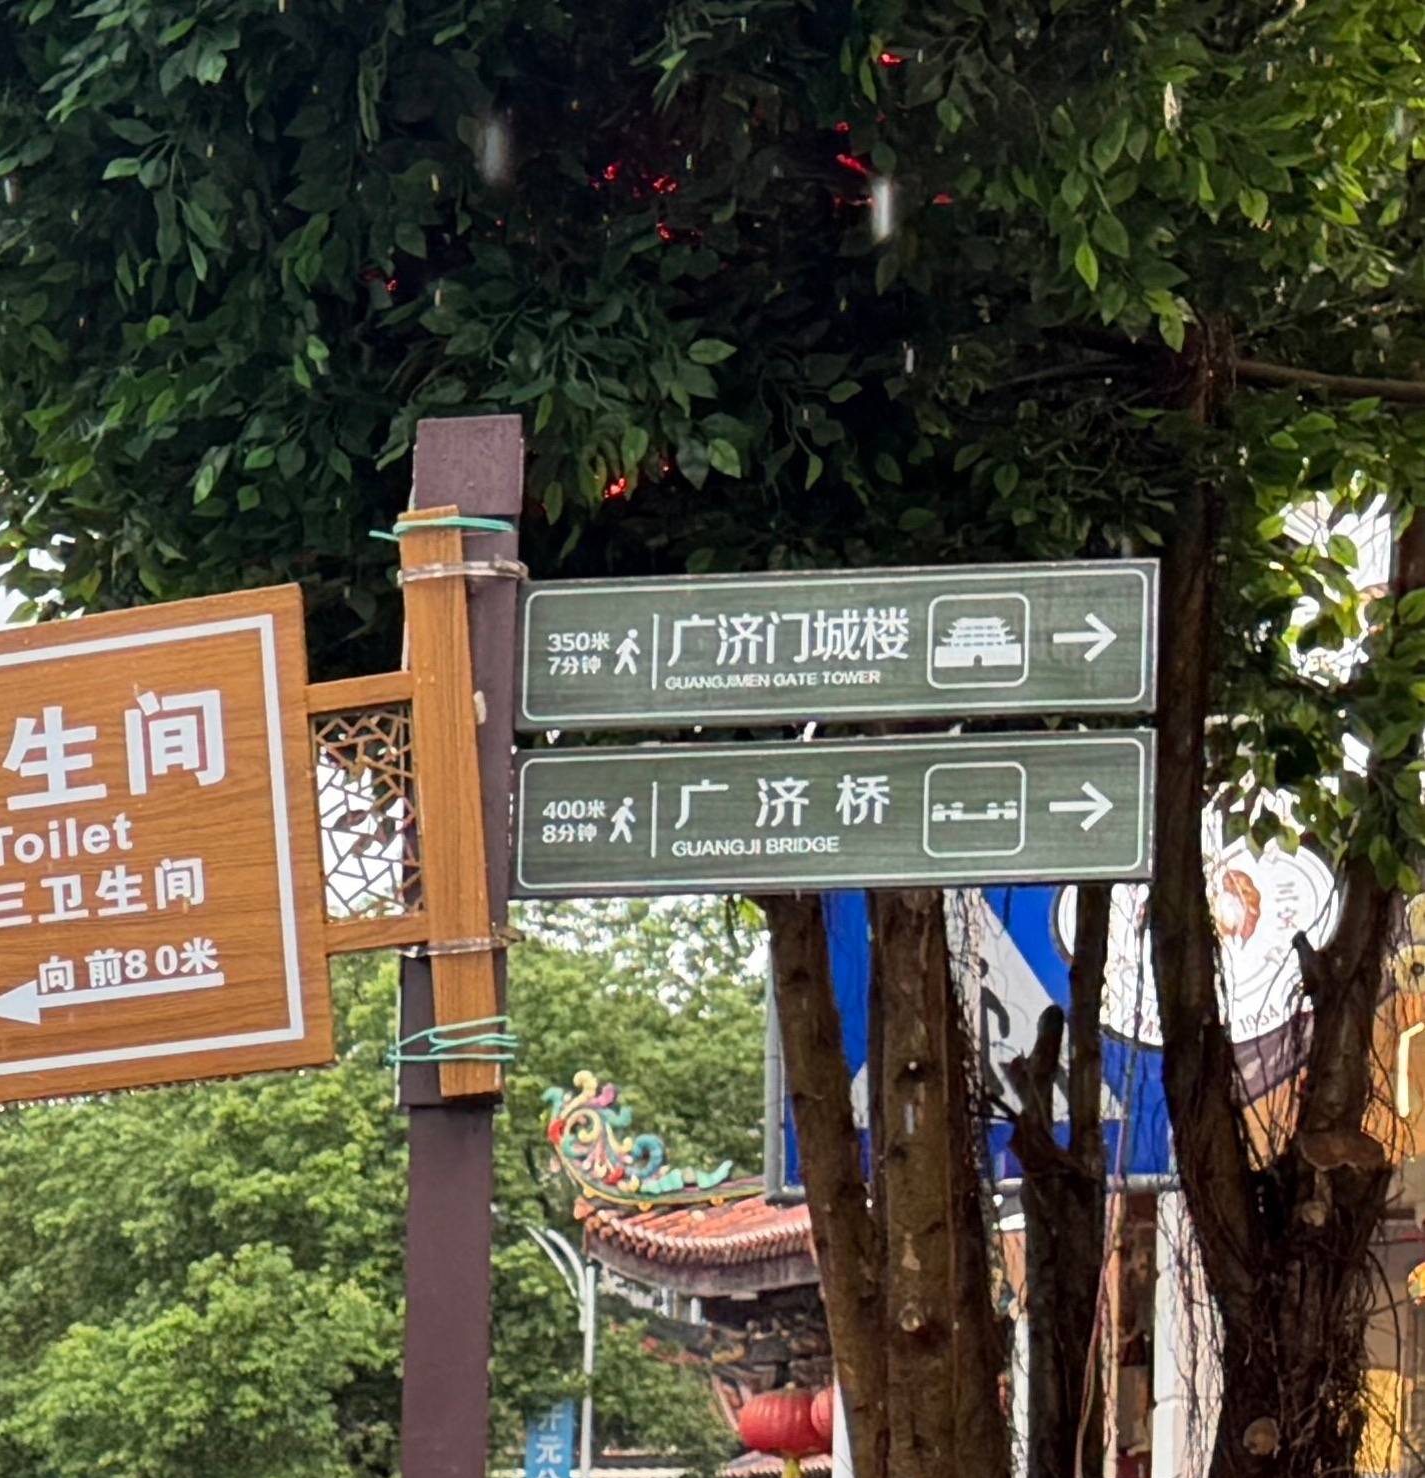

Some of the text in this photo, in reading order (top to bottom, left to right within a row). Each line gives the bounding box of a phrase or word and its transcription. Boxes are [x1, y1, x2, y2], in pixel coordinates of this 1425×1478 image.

[547, 631, 610, 652] 350米
[667, 607, 910, 667] 广济门城楼
[547, 655, 601, 676] 7分钟
[665, 669, 882, 691] GUANGJIMEN GATE TOWER
[542, 799, 606, 819] 400米
[675, 774, 890, 830] 广济桥
[542, 822, 597, 843] 8分钟
[671, 836, 840, 858] GUANGJI BRIDGE
[38, 937, 219, 994] 向前80米
